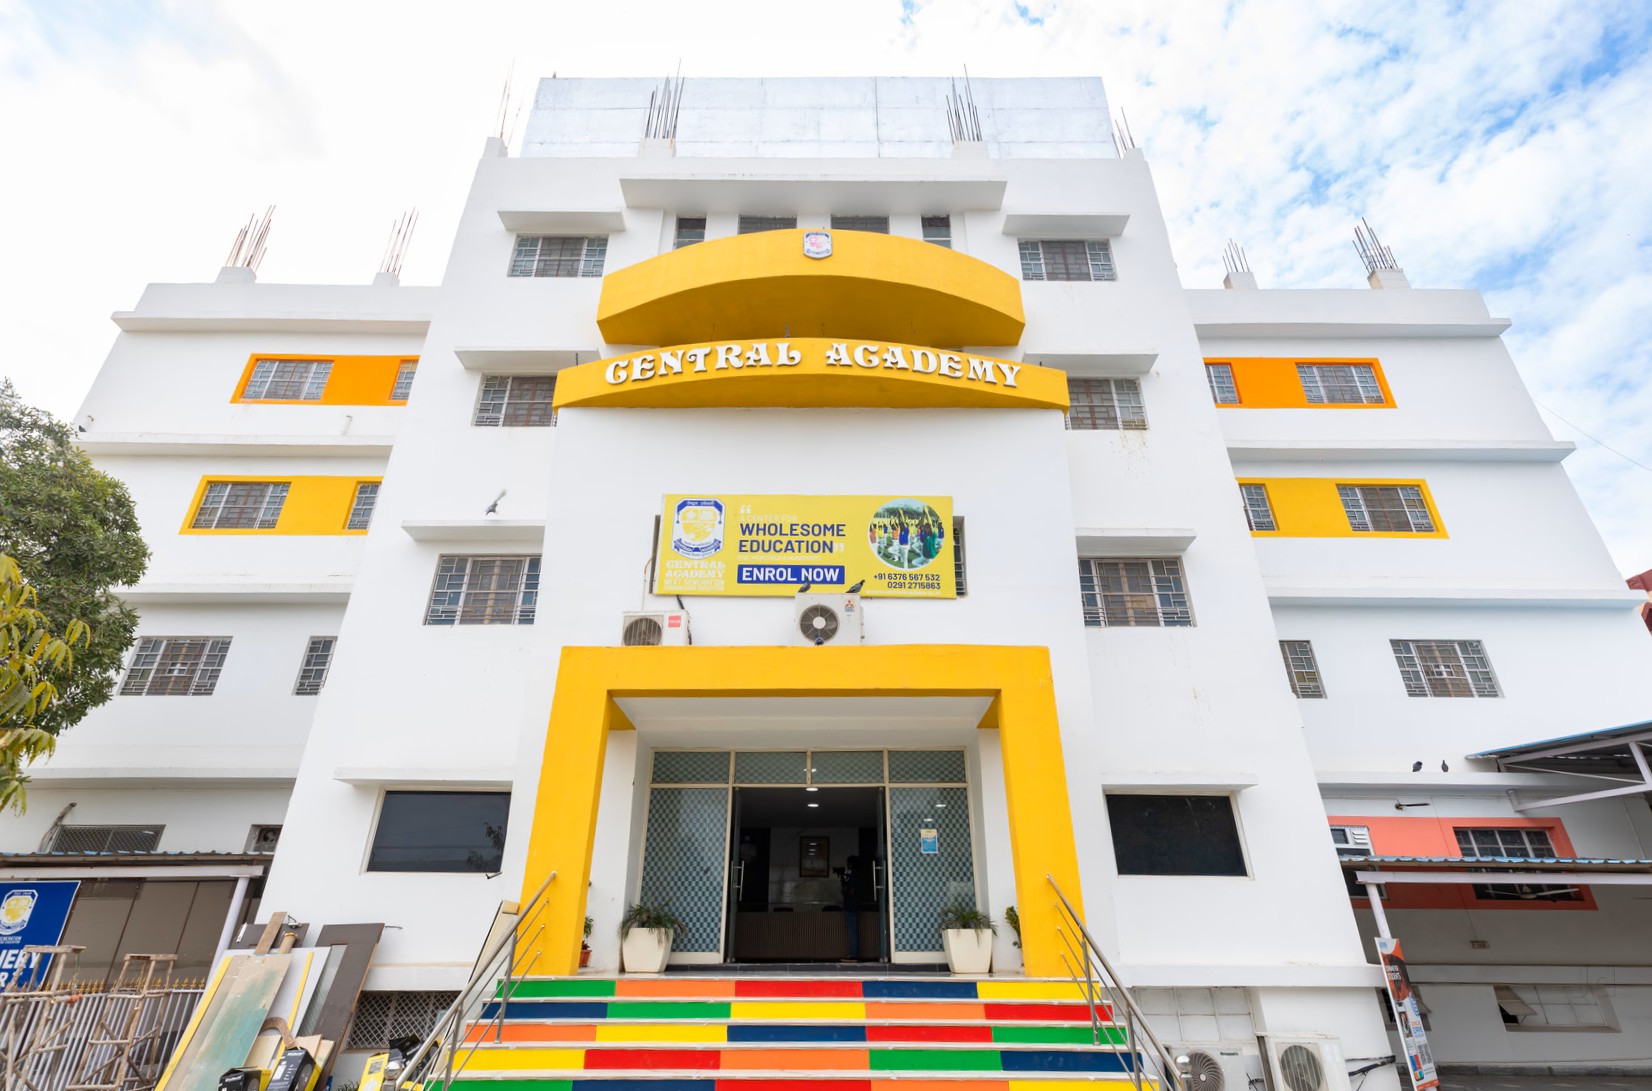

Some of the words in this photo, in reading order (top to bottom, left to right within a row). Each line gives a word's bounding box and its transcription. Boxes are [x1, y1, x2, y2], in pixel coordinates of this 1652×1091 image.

[605, 342, 802, 385] CENTRAL
[825, 342, 1021, 387] ACADEMY
[739, 523, 847, 537] WHOLESOME
[742, 567, 798, 581] ENROL
[801, 568, 840, 582] NOW
[874, 572, 886, 581] +91
[887, 573, 907, 581] 6376
[887, 581, 906, 589] 0291
